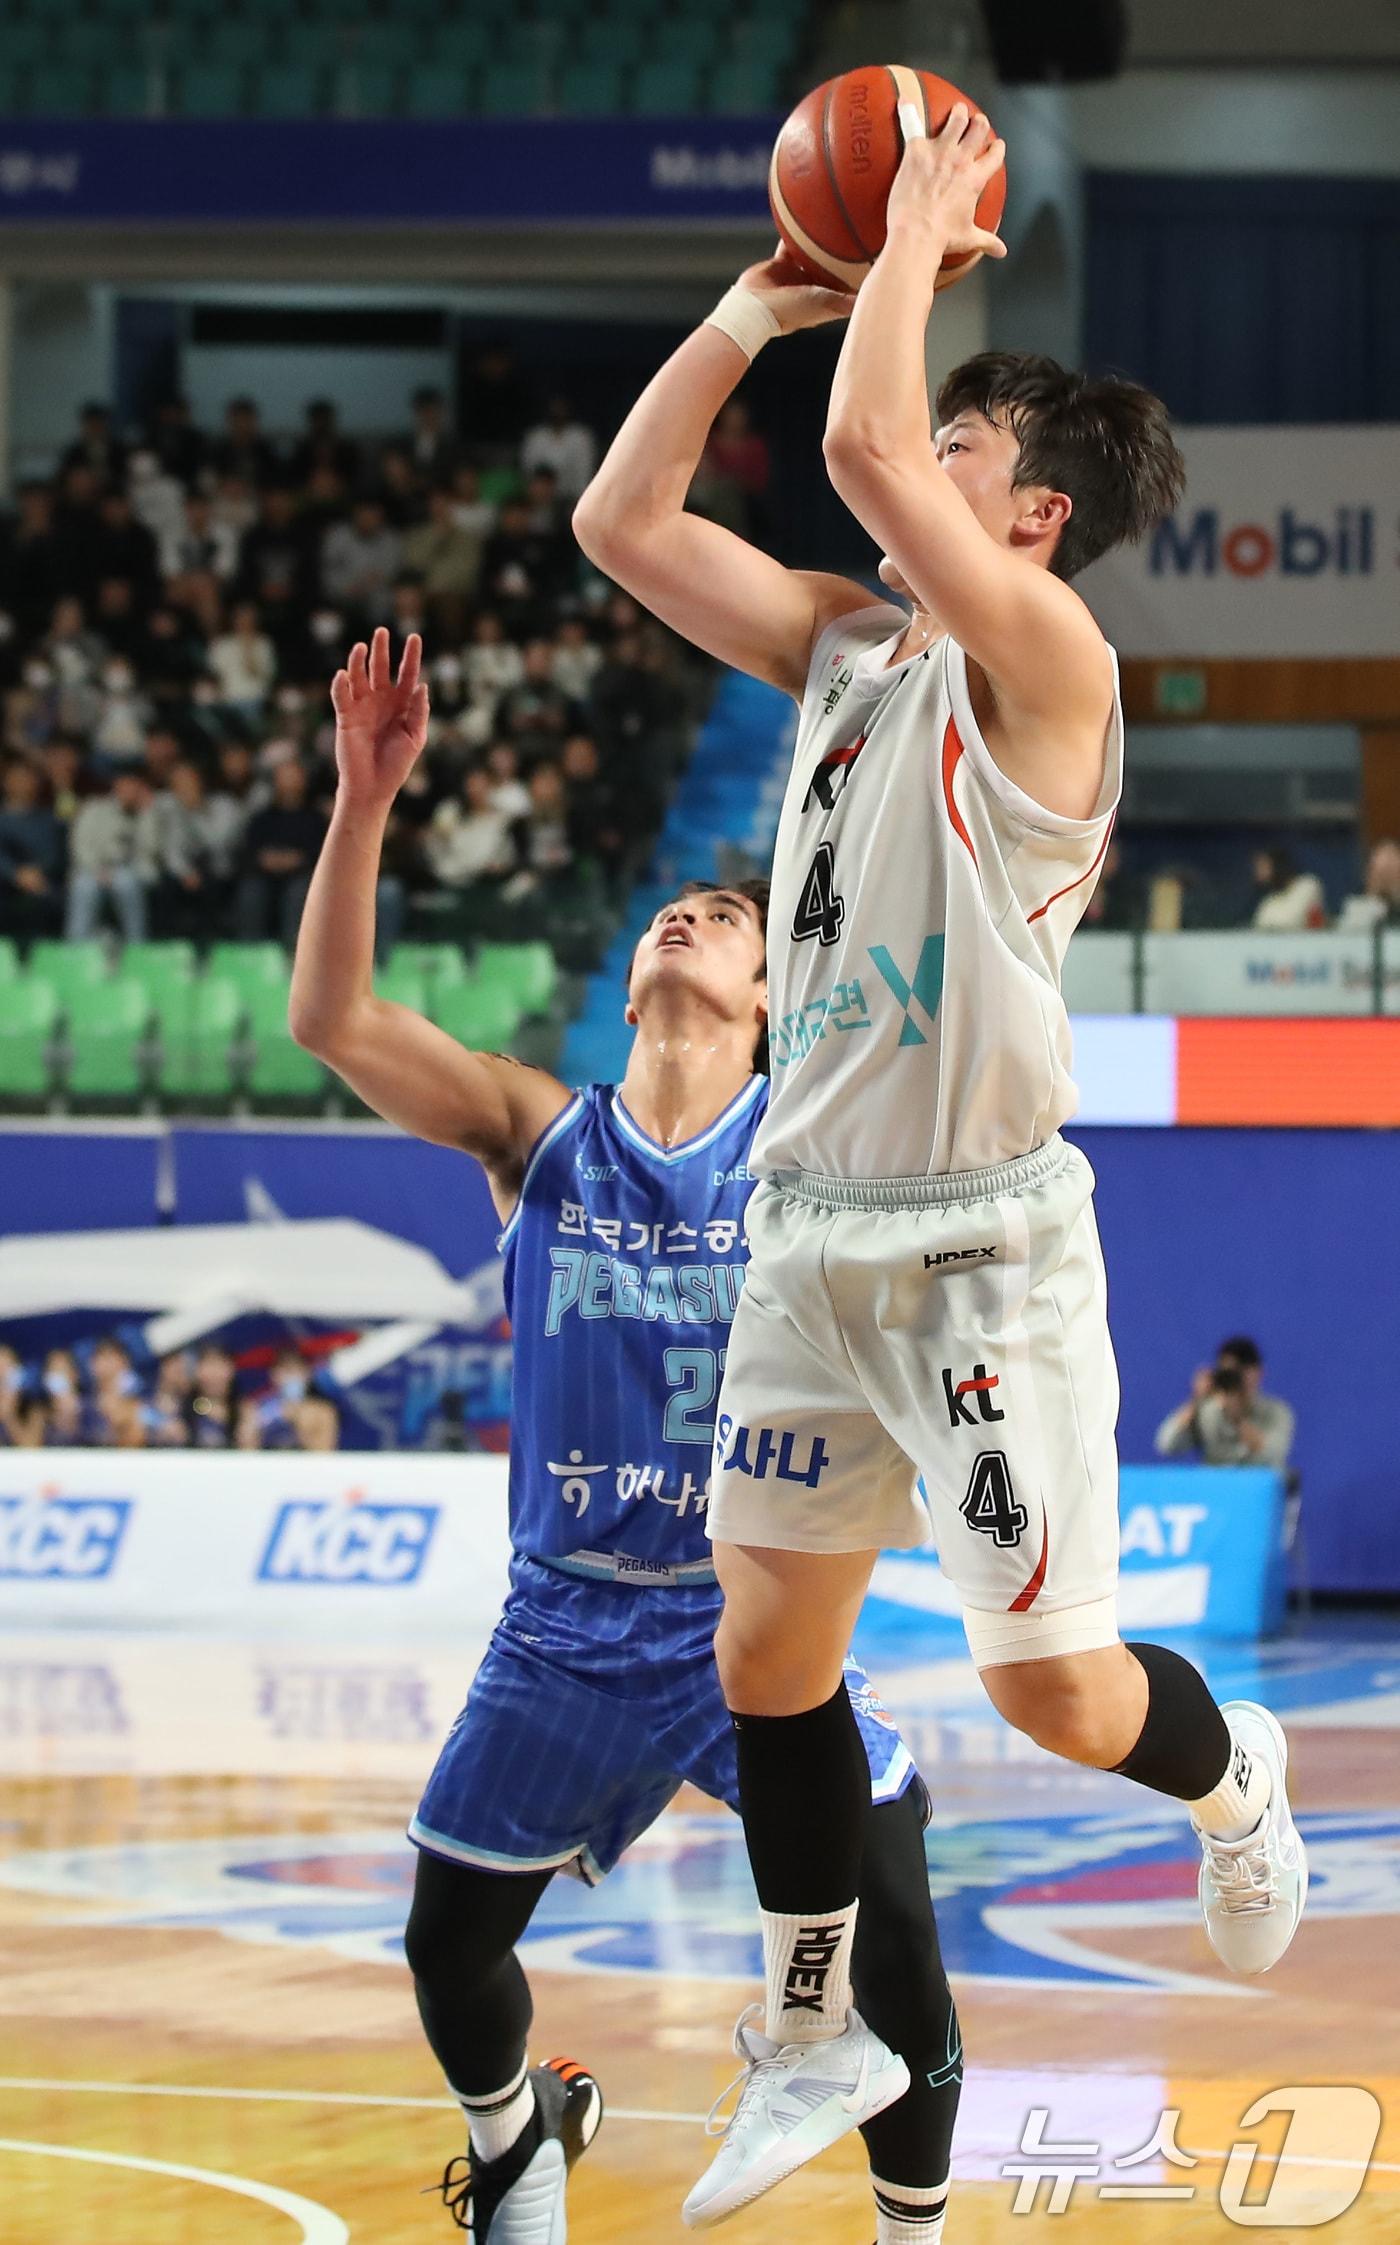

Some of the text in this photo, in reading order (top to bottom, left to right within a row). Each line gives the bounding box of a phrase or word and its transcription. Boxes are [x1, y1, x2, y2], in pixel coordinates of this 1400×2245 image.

[849, 84, 872, 175] molten
[1149, 504, 1375, 581] Mobil
[791, 841, 845, 947] 4
[557, 1199, 748, 1255] 한국가스공
[545, 1247, 746, 1337] PEGASU
[662, 1347, 727, 1444] 2
[941, 1364, 1004, 1427] kt
[281, 1498, 418, 1577] KCC
[960, 1450, 1028, 1548] 4
[617, 1557, 670, 1576] PEGASUS
[782, 1921, 847, 2014] HDEX
